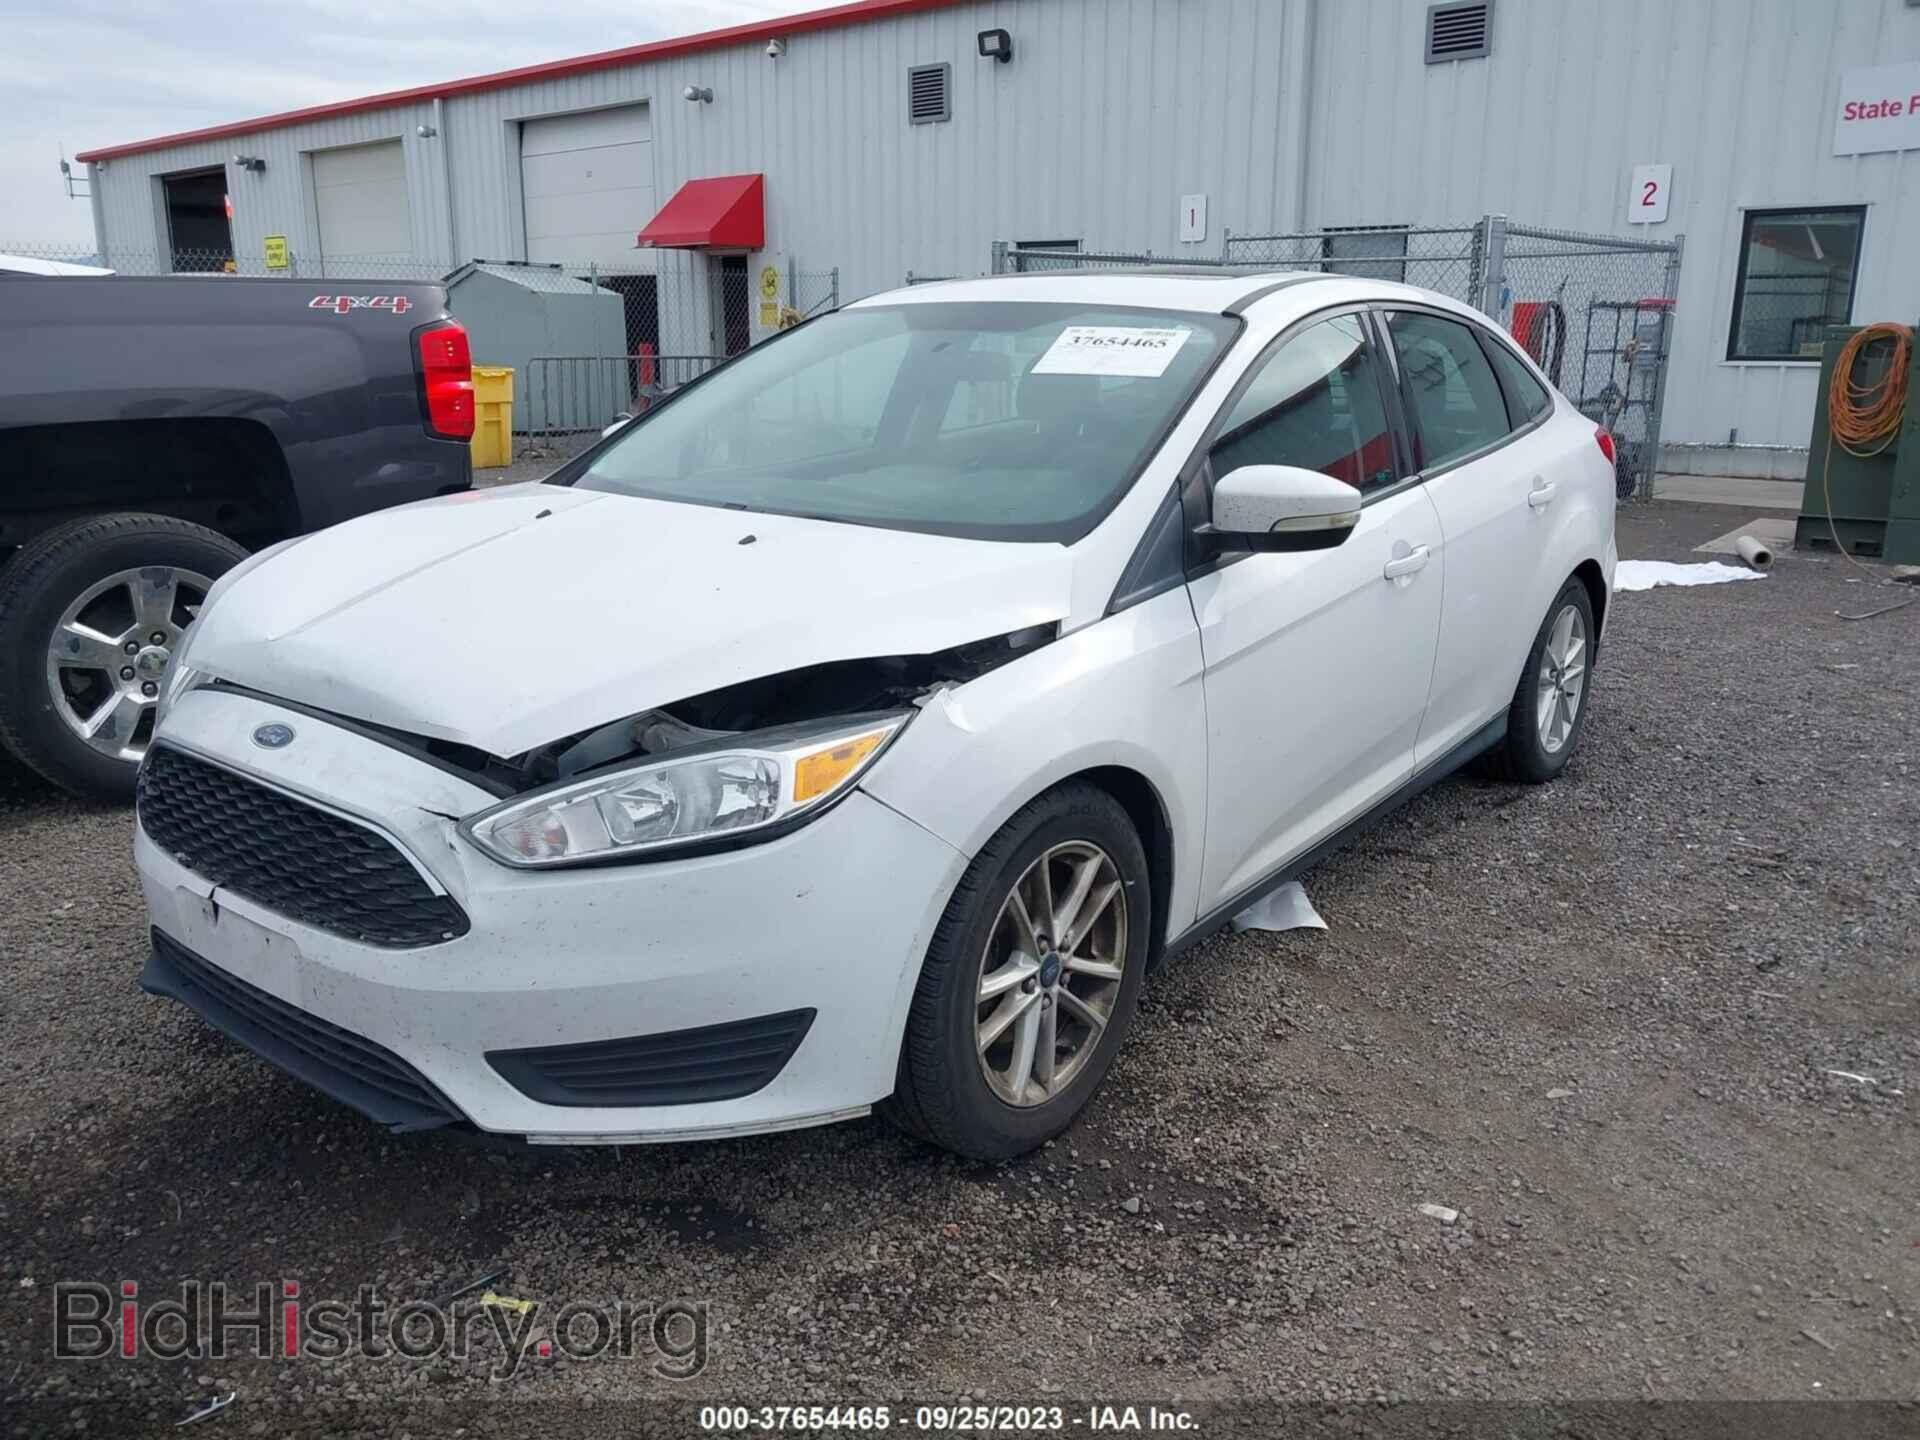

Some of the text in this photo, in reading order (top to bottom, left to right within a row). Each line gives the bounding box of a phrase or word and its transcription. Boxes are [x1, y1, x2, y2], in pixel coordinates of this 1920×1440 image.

[1843, 99, 1903, 120] State
[1642, 181, 1657, 206] 2
[256, 727, 289, 745] Ford
